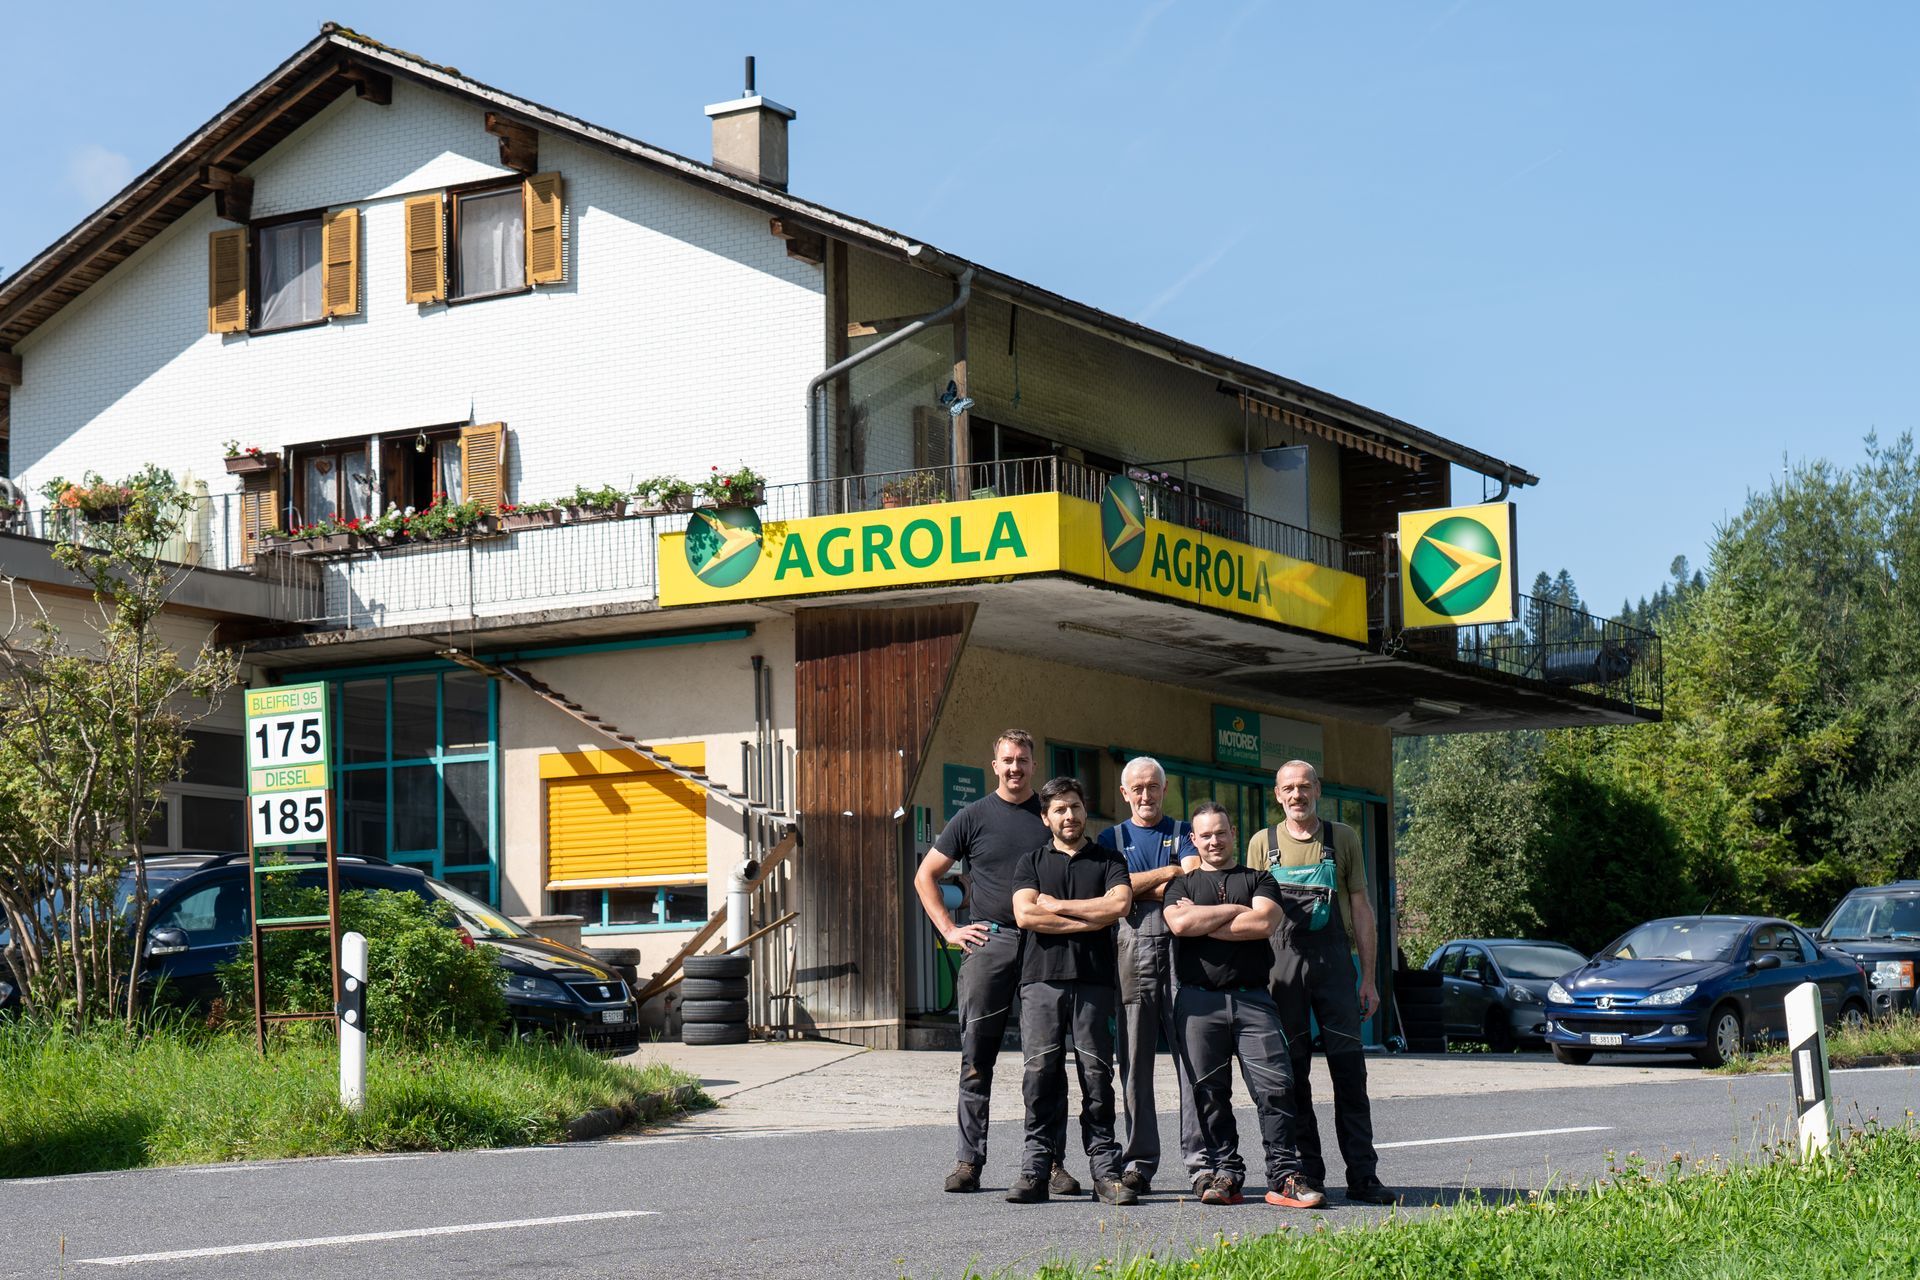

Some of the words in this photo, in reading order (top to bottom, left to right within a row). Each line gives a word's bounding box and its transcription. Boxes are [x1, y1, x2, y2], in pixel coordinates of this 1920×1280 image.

[774, 510, 1028, 581] AGROLA
[1151, 532, 1272, 607] AGROLA
[252, 692, 300, 711] BLEIFREI
[303, 691, 318, 706] 95
[256, 718, 321, 759] 175
[1218, 729, 1258, 751] MOTOREX
[265, 769, 311, 788] DIESEL
[258, 796, 325, 835] 185
